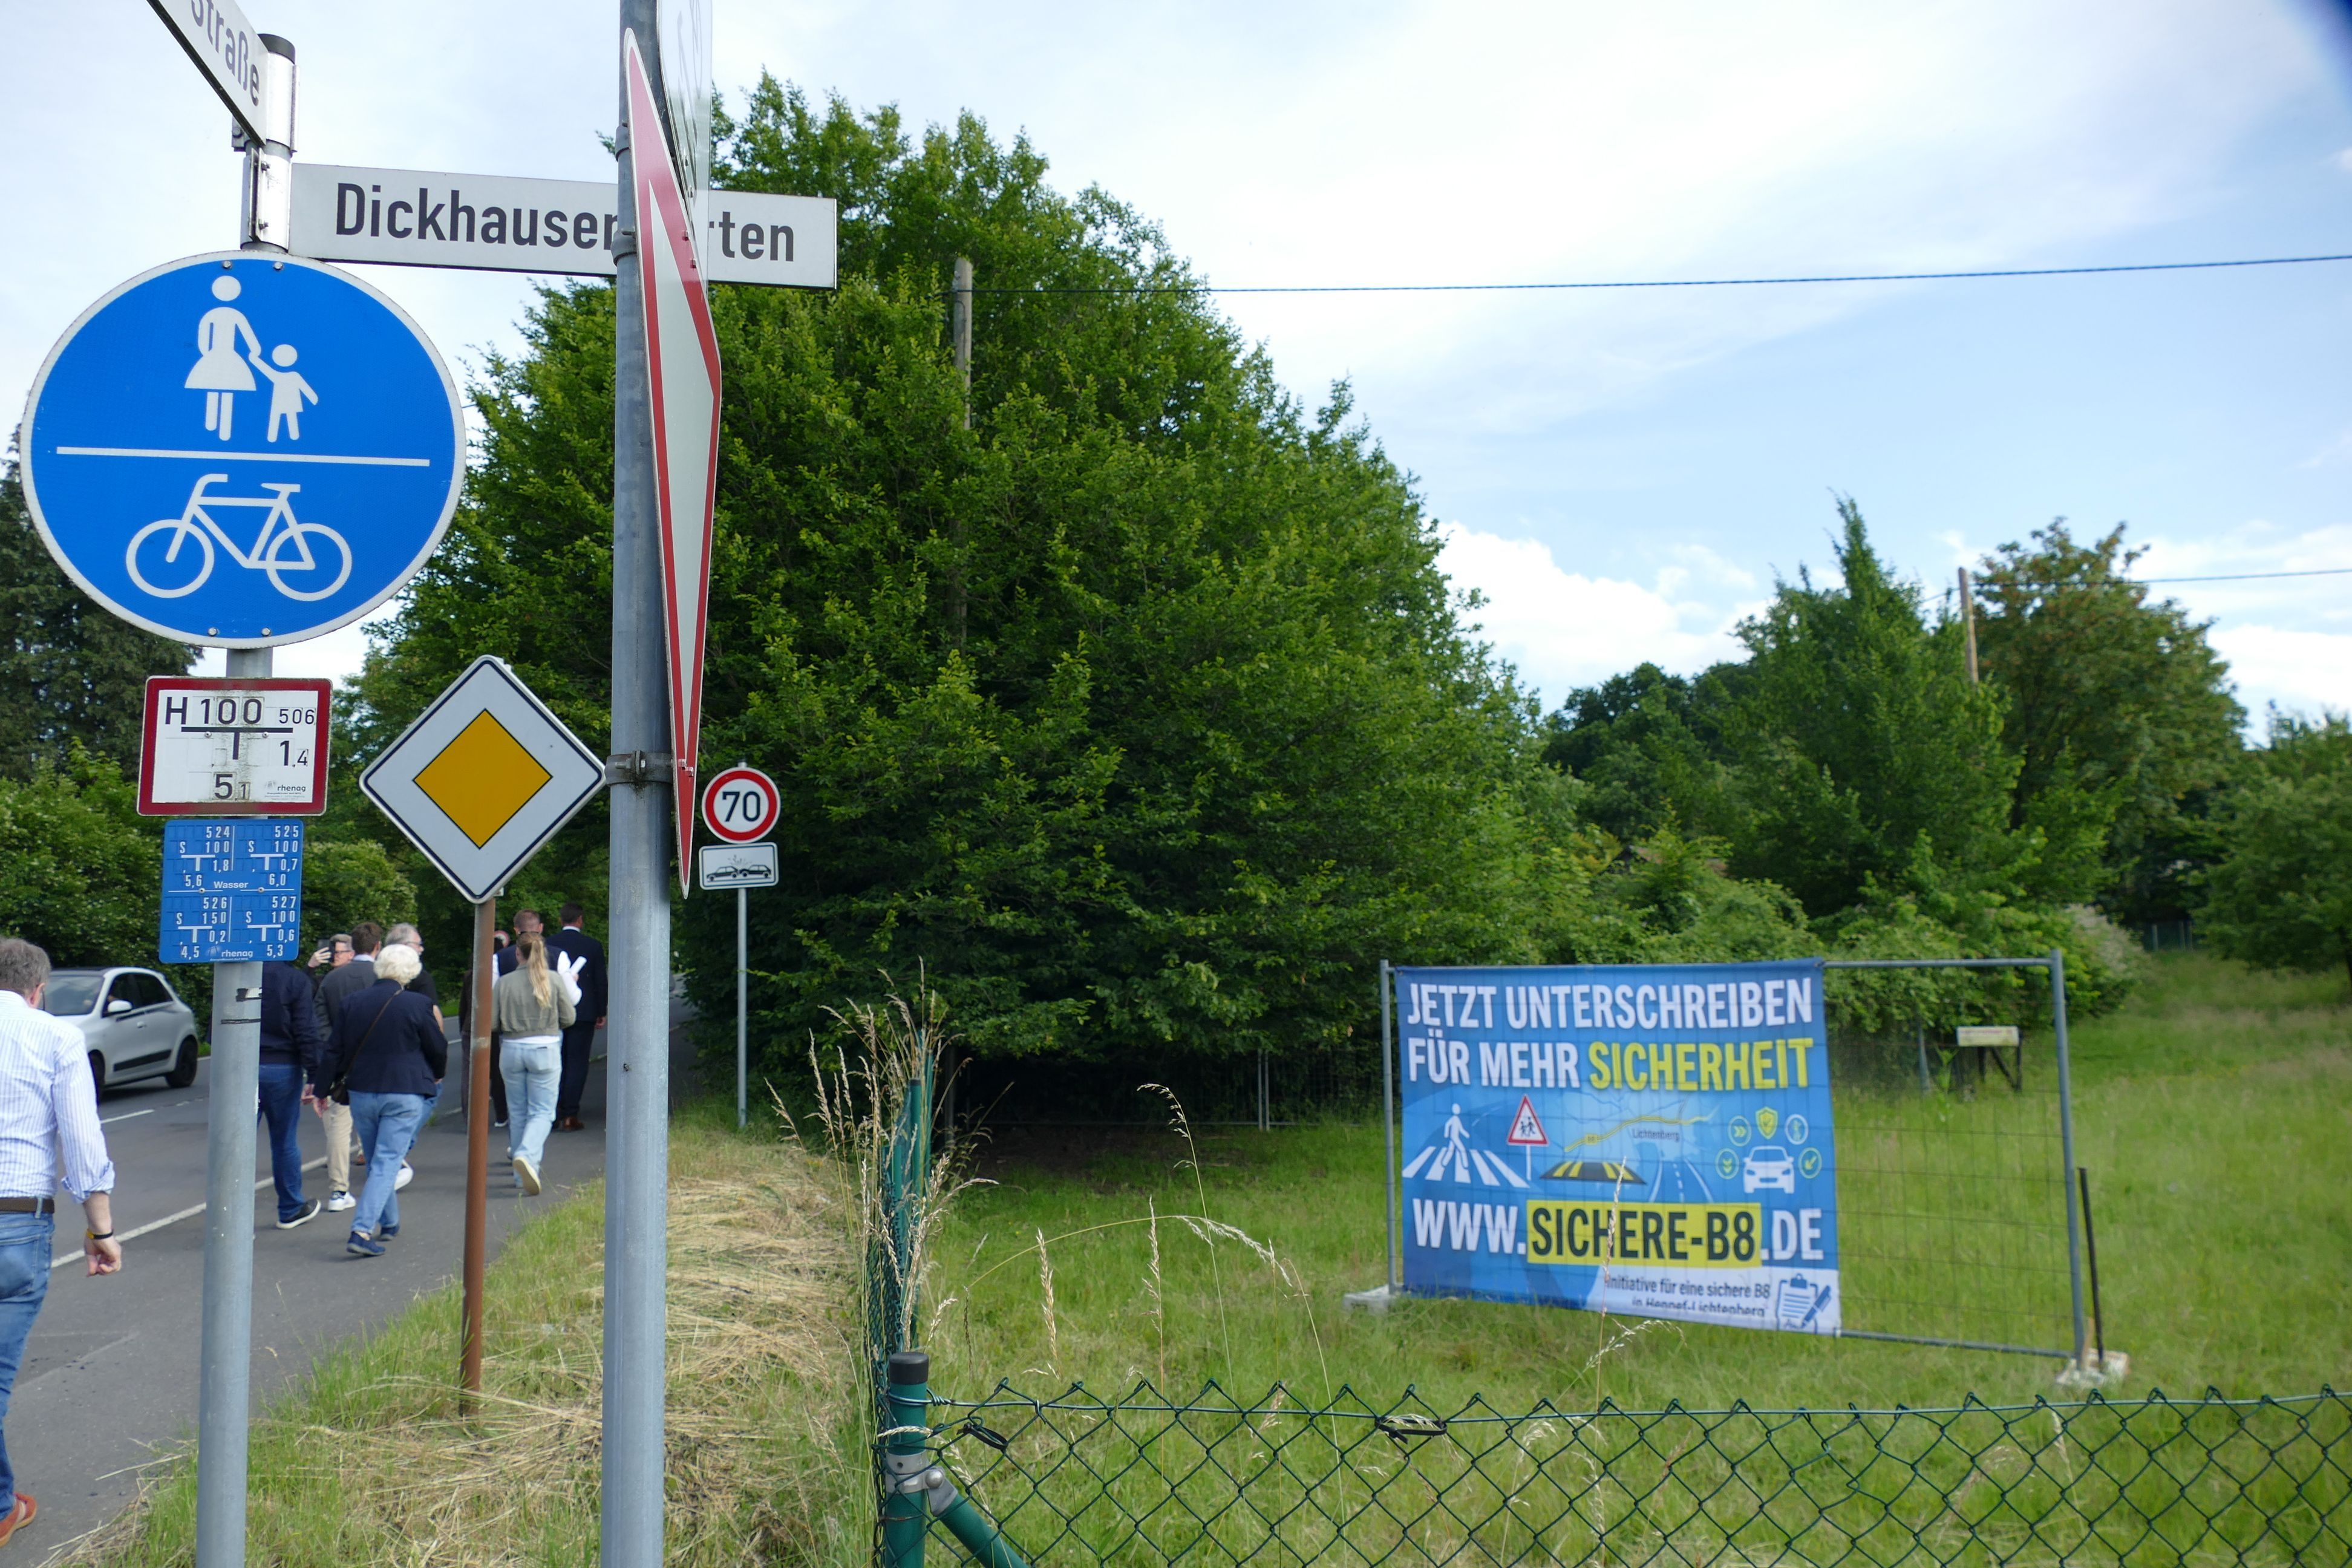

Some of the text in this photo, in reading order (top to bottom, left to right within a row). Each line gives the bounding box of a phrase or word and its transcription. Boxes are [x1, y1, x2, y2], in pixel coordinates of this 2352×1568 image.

[165, 697, 315, 725] H 100 506
[280, 740, 307, 767] 1,4
[722, 791, 760, 822] 70
[206, 826, 230, 838] 524
[275, 825, 299, 838] 525
[180, 841, 229, 854] S 100
[248, 840, 298, 852] S 100
[213, 859, 229, 873] 1,8
[281, 858, 298, 872] 0,7
[185, 875, 202, 888] 5,6
[269, 874, 286, 887] 6,0
[203, 897, 227, 909] 526
[272, 896, 296, 908] 527
[177, 912, 226, 925] S 150
[246, 910, 295, 923] S 100
[209, 930, 226, 944] 0,2
[278, 929, 294, 943] 0,6
[181, 946, 200, 960] 4,5
[221, 949, 253, 958] rhenag
[267, 944, 283, 958] 5,3
[1408, 977, 1812, 1030] JETZT UNTERSCHREIBEN
[1408, 1029, 1813, 1091] FÜR MEHR SICHERHEIT
[1633, 1129, 1680, 1143] Lichtenberg
[1659, 1278, 1677, 1294] für
[1679, 1280, 1704, 1296] eine
[1707, 1282, 1751, 1298] sichere
[1755, 1283, 1771, 1299] B8
